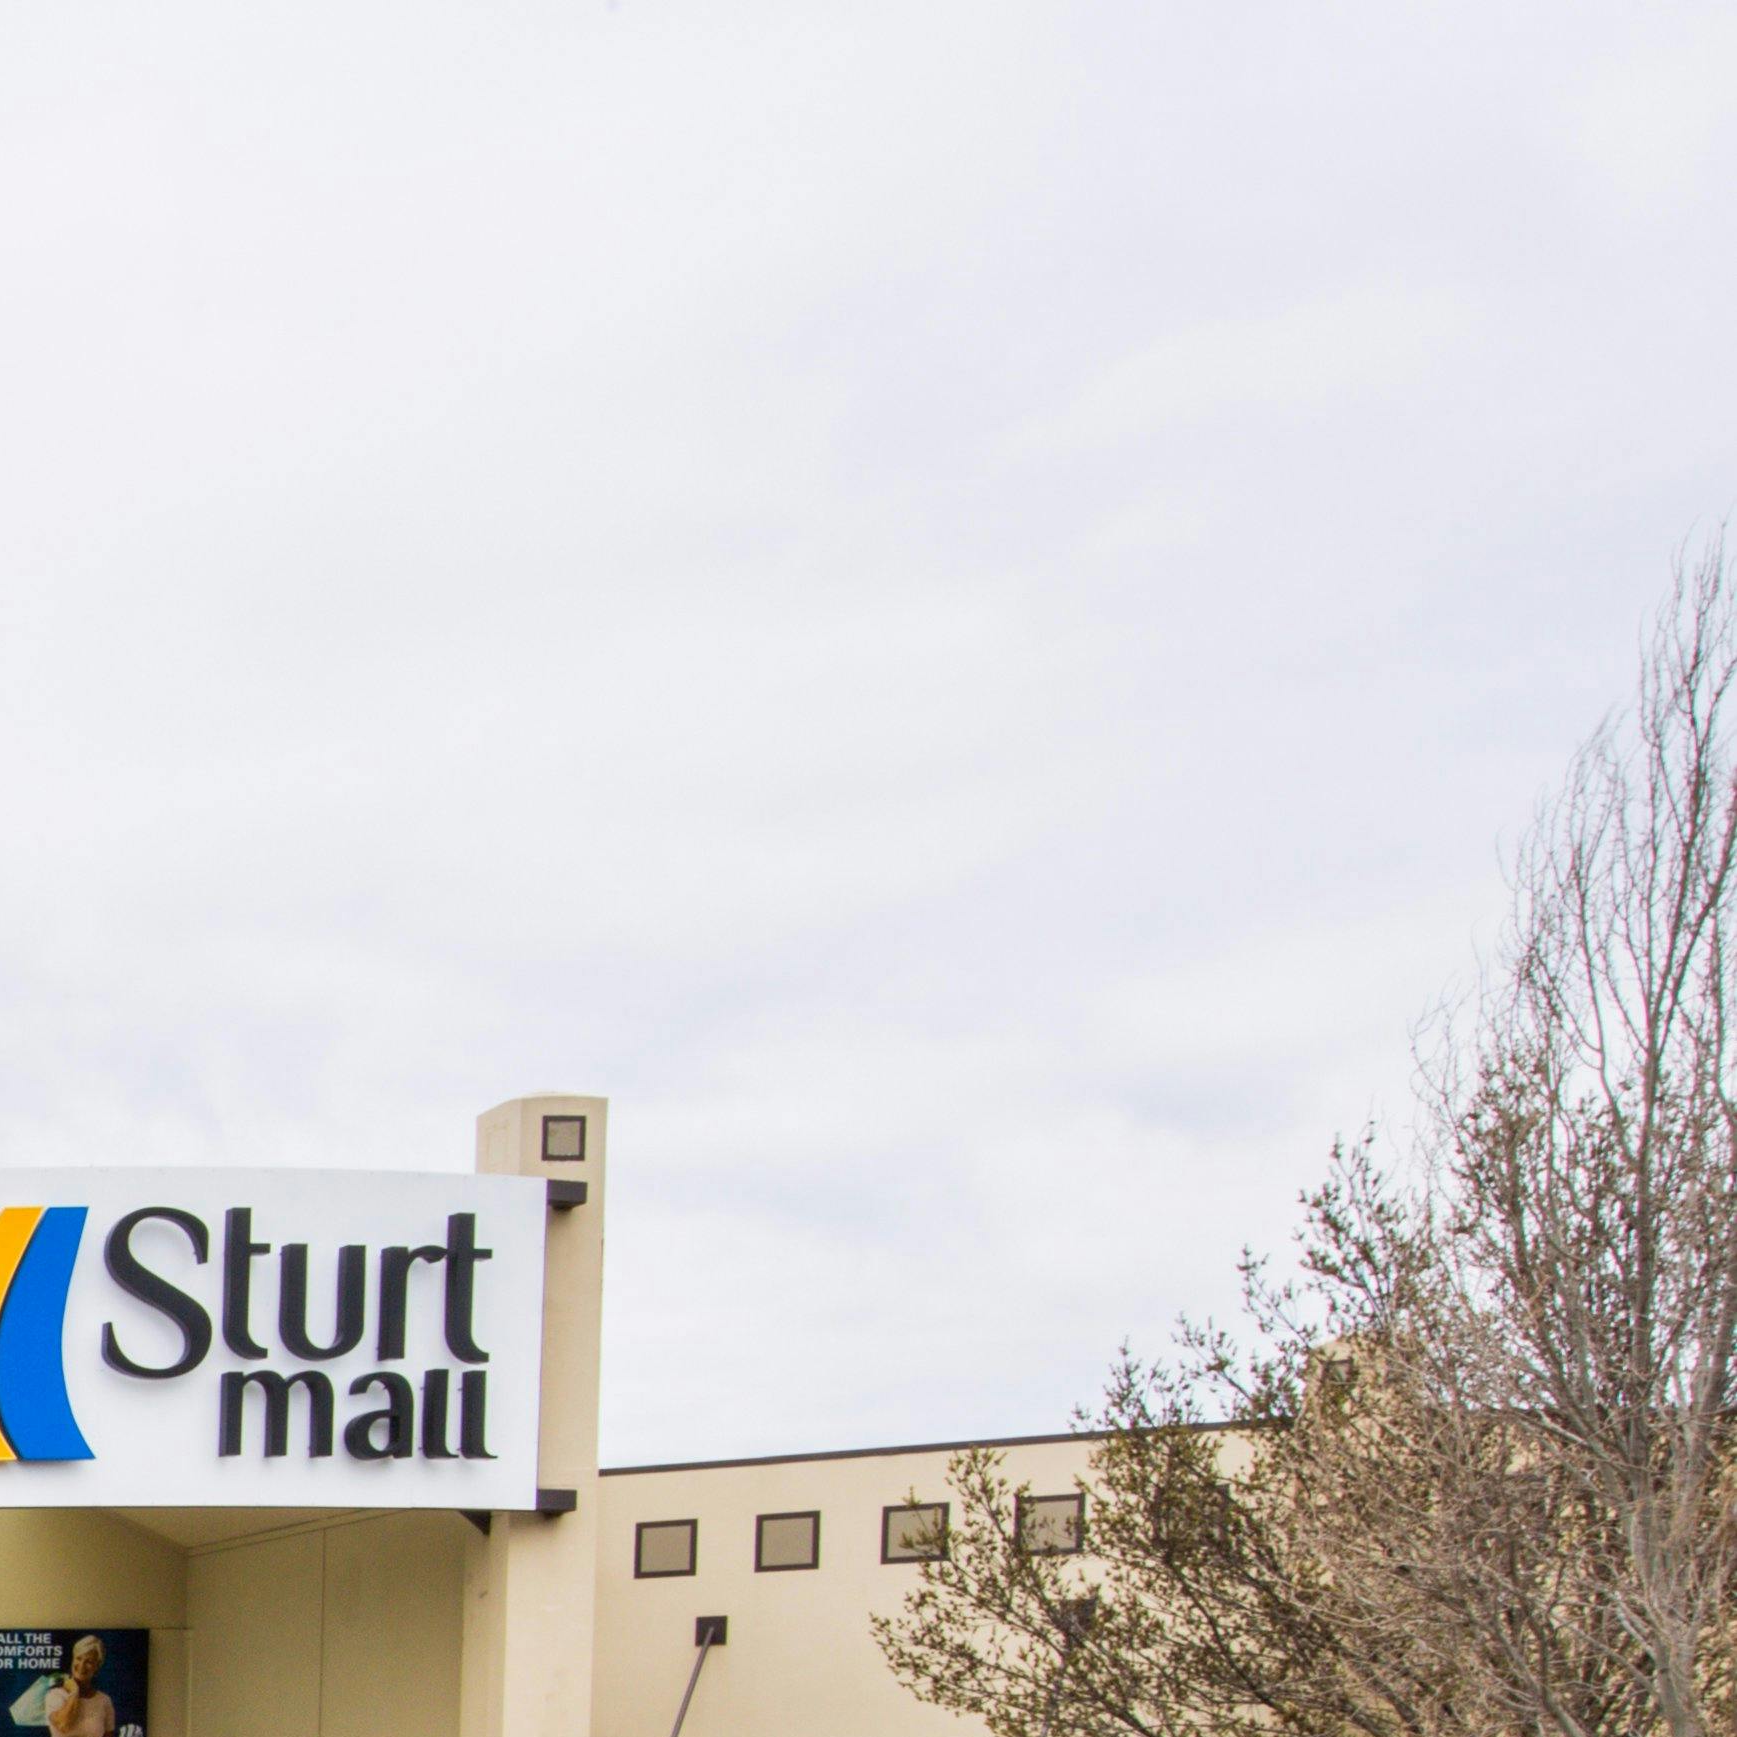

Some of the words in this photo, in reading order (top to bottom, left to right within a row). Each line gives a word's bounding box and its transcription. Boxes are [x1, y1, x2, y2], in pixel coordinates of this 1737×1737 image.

[101, 1206, 493, 1380] Sturt
[219, 1368, 498, 1460] mall
[18, 1658, 60, 1669] HOME
[24, 1633, 52, 1644] THE
